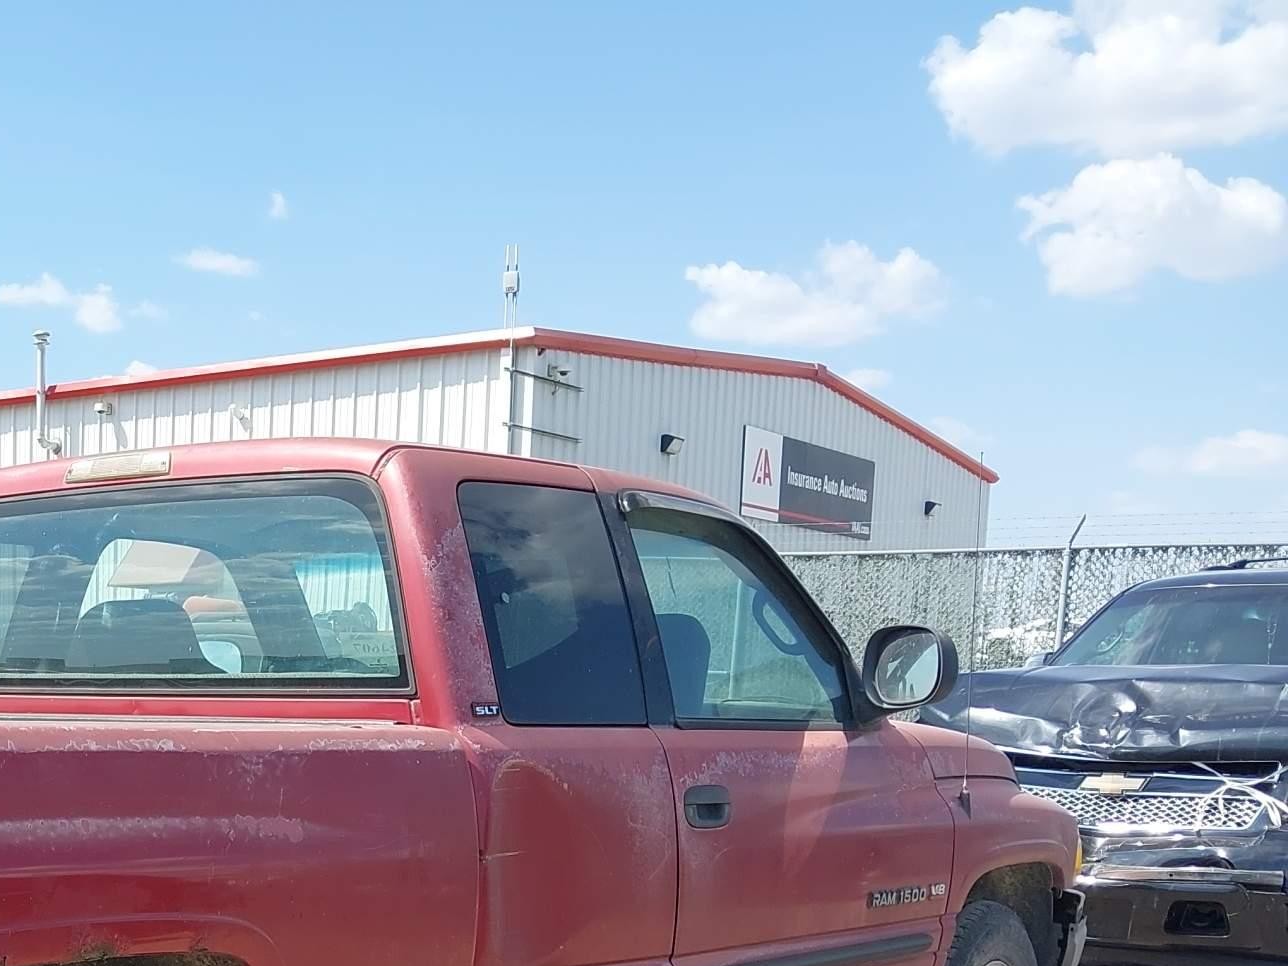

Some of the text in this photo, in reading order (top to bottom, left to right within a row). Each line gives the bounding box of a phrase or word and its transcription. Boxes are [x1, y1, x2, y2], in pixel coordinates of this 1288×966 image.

[787, 465, 867, 503] Insurance Auto Auctions
[475, 705, 499, 715] SLT
[872, 892, 896, 908] RAM
[900, 888, 927, 903] 1500
